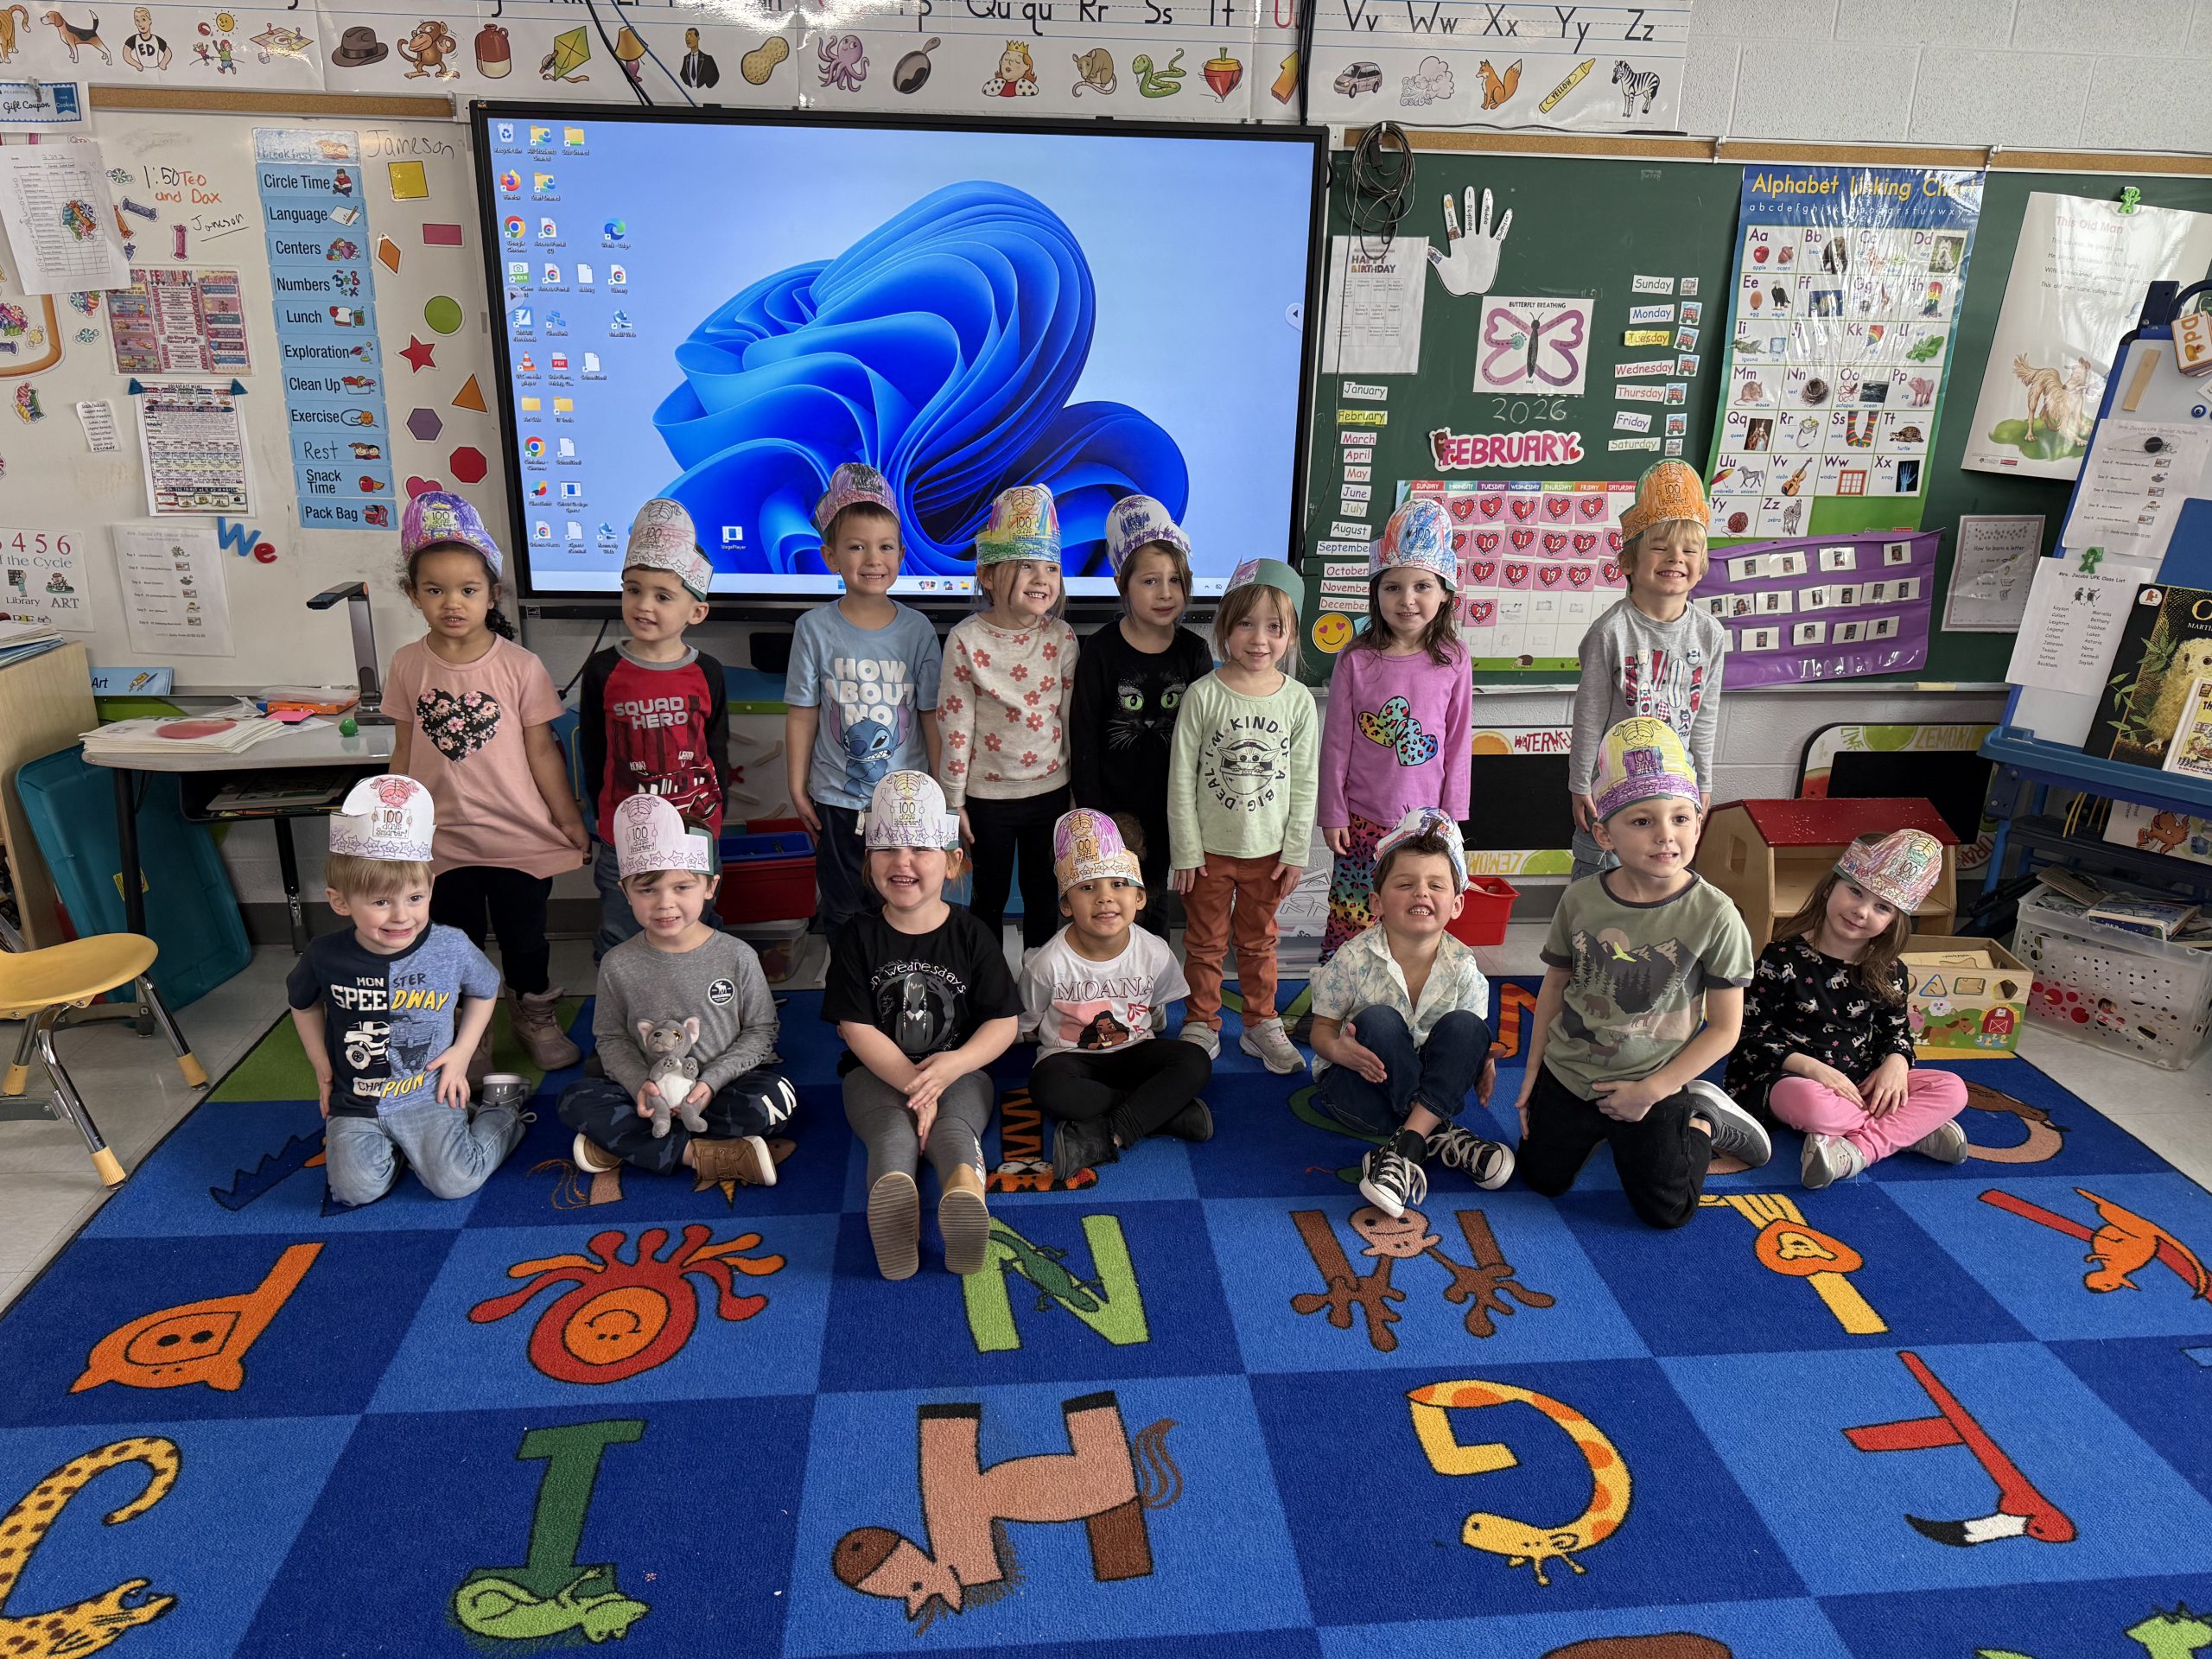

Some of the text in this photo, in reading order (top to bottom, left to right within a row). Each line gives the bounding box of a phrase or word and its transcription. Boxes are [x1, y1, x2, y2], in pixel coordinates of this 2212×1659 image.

[1407, 0, 1459, 35] Ww
[1483, 3, 1519, 37] Xx
[1554, 6, 1591, 54] Yy
[1625, 9, 1654, 41] Zz
[138, 43, 156, 59] ED
[1551, 78, 1573, 100] YELLOW
[22, 100, 51, 111] Coupon
[367, 130, 454, 160] Jameson
[264, 174, 331, 190] Circle Time
[1751, 173, 1840, 199] Alphabet
[155, 188, 222, 205] and Dax
[270, 207, 328, 225] Language
[1748, 228, 1769, 242] Aa
[1804, 229, 1822, 243] Bb
[1913, 232, 1932, 246] Dd
[276, 240, 321, 255] Centers
[1351, 264, 1396, 274] BIRTHDAY
[276, 277, 331, 292] Numbers
[1634, 279, 1672, 292] Sunday
[1743, 276, 1759, 289] Ee
[1798, 276, 1811, 289] Ff
[286, 309, 322, 324] Lunch
[1632, 308, 1672, 322] Monday
[1846, 323, 1863, 337] Kk
[2180, 315, 2202, 343] Dd
[1628, 332, 1669, 346] Tuesday
[285, 345, 350, 360] Exploration
[1616, 363, 1674, 375] Wednesday
[1733, 367, 1758, 380] Mm
[1787, 368, 1807, 381] Nn
[1892, 369, 1908, 385] Pp
[289, 377, 340, 393] Clean Up
[1344, 384, 1386, 398] January
[1618, 386, 1664, 400] Thursday
[291, 410, 340, 423] Exercise
[1338, 410, 1385, 424] February
[1491, 397, 1567, 424] 2026
[1616, 414, 1649, 429] Friday
[1727, 412, 1748, 428] Qq
[1884, 412, 1896, 425] Tt
[1343, 434, 1376, 444] March
[1611, 440, 1657, 450] Saturday
[304, 440, 339, 460] Rest
[1345, 449, 1370, 461] April
[1441, 433, 1577, 467] FEBRUARY
[1719, 455, 1737, 467] Uu
[1824, 455, 1850, 468] Ww
[1874, 455, 1892, 469] Xx
[307, 469, 342, 482] Snack
[1347, 468, 1368, 480] May
[309, 481, 336, 494] Time
[1342, 488, 1367, 499] June
[1664, 484, 1681, 495] 100
[1343, 503, 1365, 515] July
[1460, 503, 1594, 516] 2 3 4 5 6
[1711, 497, 1727, 512] Yy
[1763, 498, 1781, 511] Zz
[305, 506, 359, 522] Pack Bag
[432, 511, 450, 520] 100
[1016, 516, 1032, 528] 100
[1332, 523, 1368, 537] August
[12, 532, 71, 555] 4 5 6
[1483, 537, 1494, 549] 10
[1518, 535, 1528, 545] 11
[1550, 538, 1561, 550] 12
[1580, 538, 1591, 550] 13
[8, 555, 73, 569] the Cycle
[1326, 566, 1369, 576] October
[1479, 566, 1619, 582] 17 18 19 20 21
[6, 596, 79, 609] Library ART
[1320, 599, 1369, 611] December
[1476, 607, 1487, 617] 24
[2187, 622, 2212, 632] MARTI
[834, 657, 907, 683] HOW
[92, 677, 109, 689] Art
[825, 682, 915, 705] ABOUT
[613, 696, 684, 716] SQUAD
[631, 711, 689, 730] HERO
[844, 704, 893, 728] NO
[1230, 715, 1279, 734] KIND
[1205, 767, 1236, 810] DEAL
[1247, 788, 1274, 812] BIG
[899, 802, 916, 814] 100
[383, 810, 403, 823] 100
[382, 822, 403, 830] days
[632, 826, 649, 840] 100
[1075, 838, 1091, 852] 100
[356, 972, 426, 988] MON STER
[1052, 976, 1156, 1002] MOANA
[330, 983, 450, 1013] SPEE DWAY
